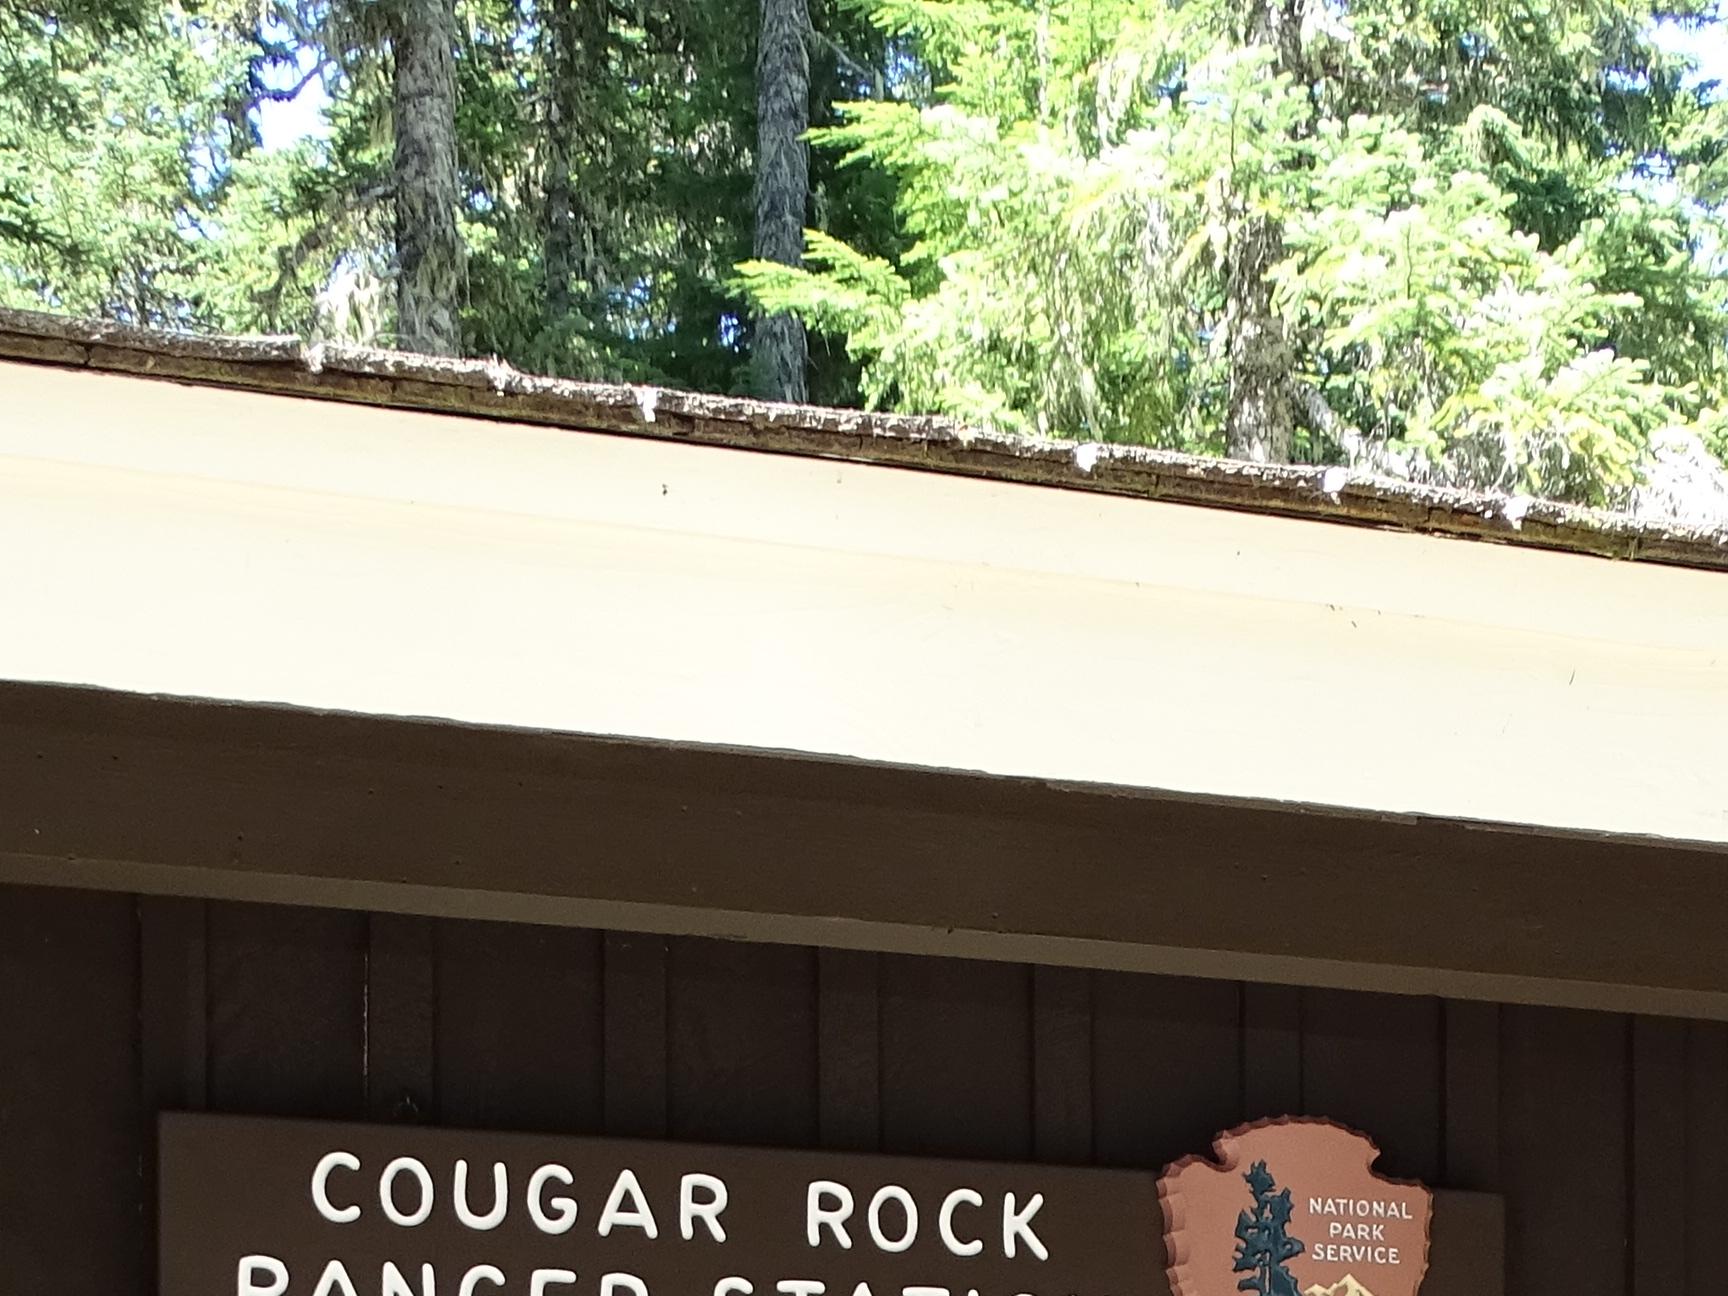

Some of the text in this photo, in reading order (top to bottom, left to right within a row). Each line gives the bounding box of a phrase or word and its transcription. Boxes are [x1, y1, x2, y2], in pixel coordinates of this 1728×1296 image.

[311, 1151, 1050, 1261] COUGAR ROCK
[1308, 1197, 1414, 1220] NATIONAL
[1329, 1221, 1385, 1241] PARK
[1311, 1243, 1401, 1265] SERVICE
